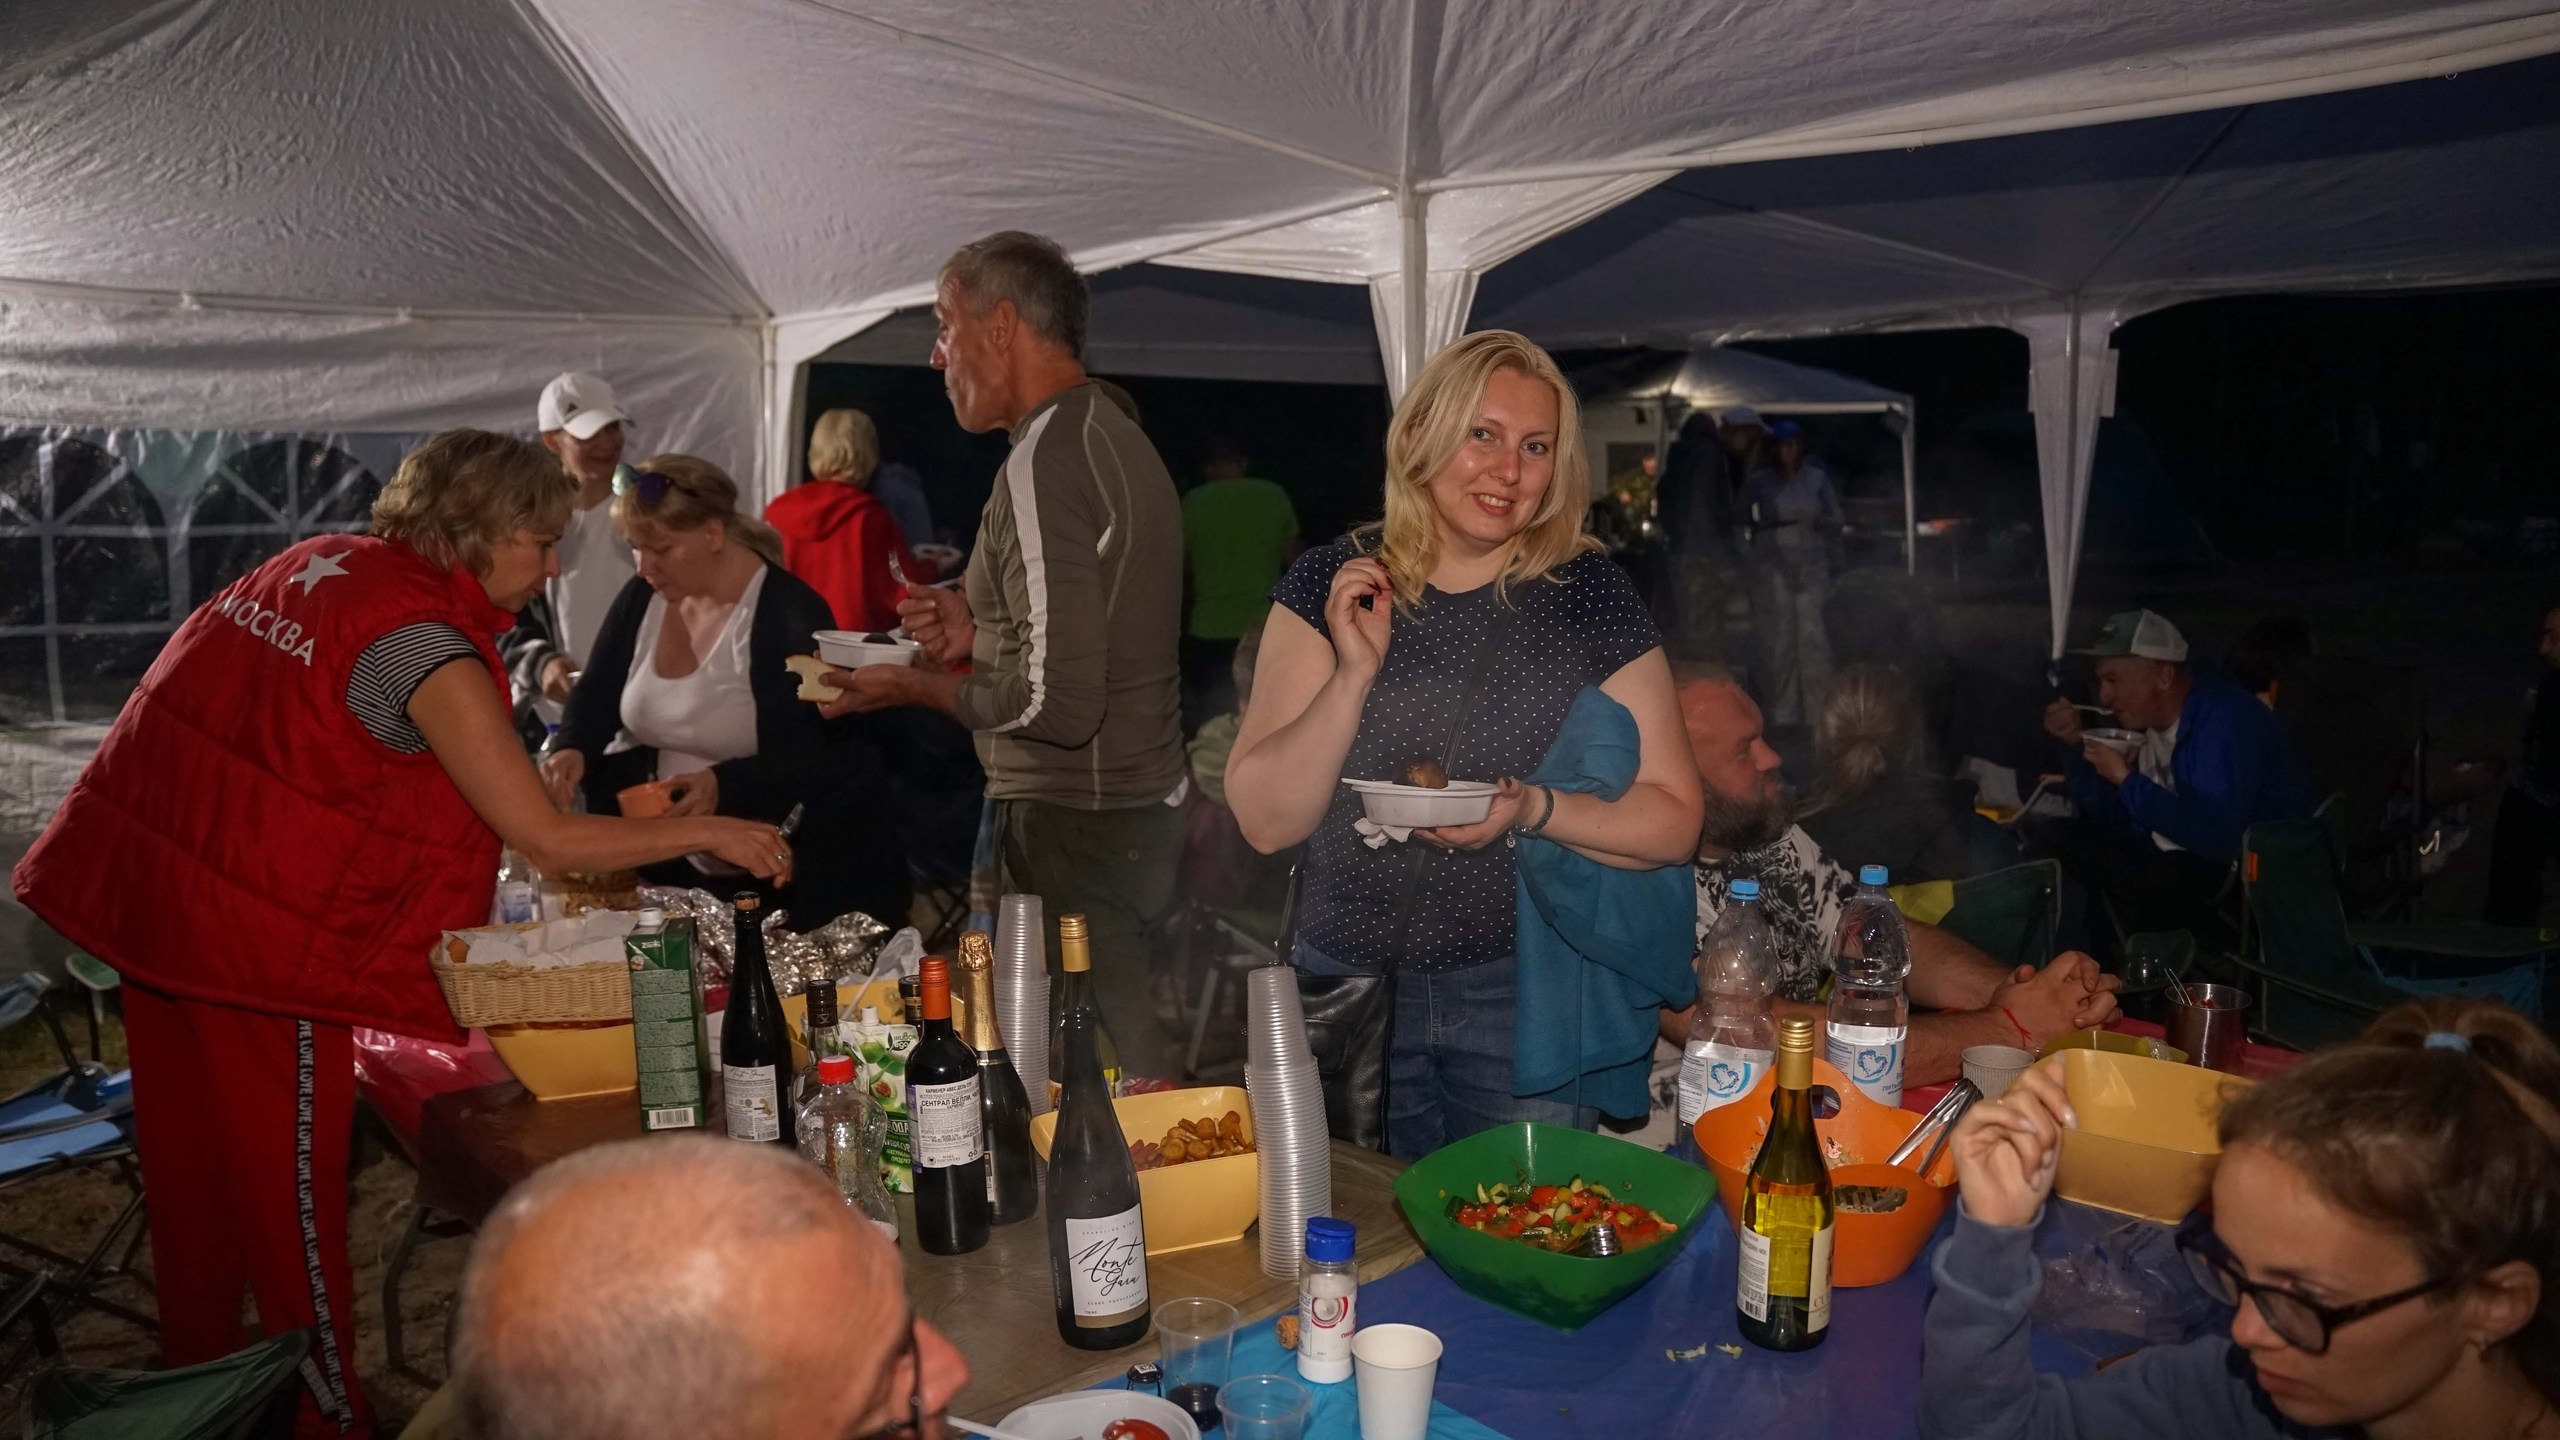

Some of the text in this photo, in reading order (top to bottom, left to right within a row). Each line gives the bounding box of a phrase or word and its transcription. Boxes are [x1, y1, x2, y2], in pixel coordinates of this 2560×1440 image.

[216, 595, 316, 667] МОСКВА
[299, 1039, 313, 1067] LOVE
[299, 1068, 313, 1096] LOVE
[298, 1097, 312, 1125] LOVE
[921, 1099, 951, 1107] СЕНТРАЛ
[298, 1125, 312, 1153] LOVE
[298, 1154, 312, 1182] LOVE
[299, 1182, 314, 1212] LOVE
[1069, 1236, 1144, 1283] Monte
